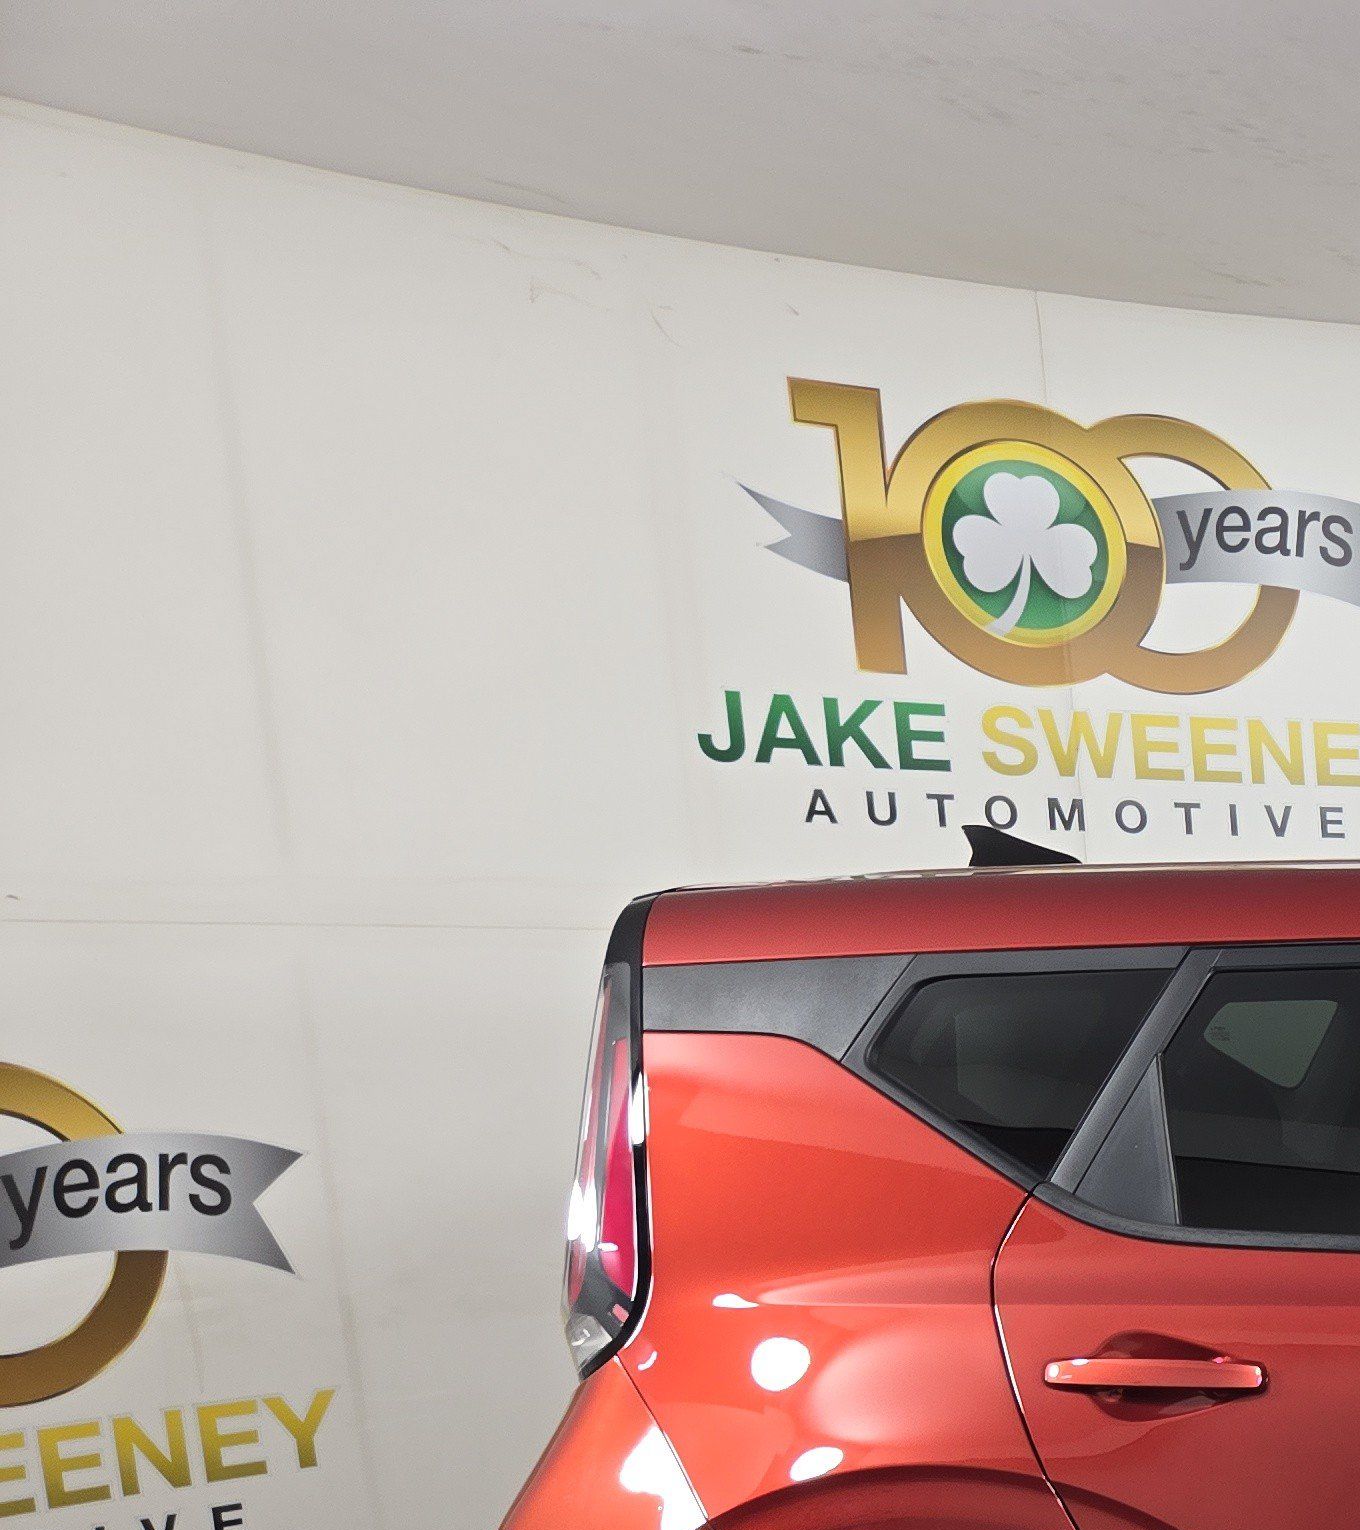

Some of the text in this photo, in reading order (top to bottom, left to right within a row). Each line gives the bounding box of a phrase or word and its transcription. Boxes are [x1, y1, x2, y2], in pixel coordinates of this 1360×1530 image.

[1175, 504, 1355, 570] years
[697, 690, 953, 773] JAKE
[804, 788, 1347, 839] AUTOMOTIVE
[0, 1151, 233, 1251] years
